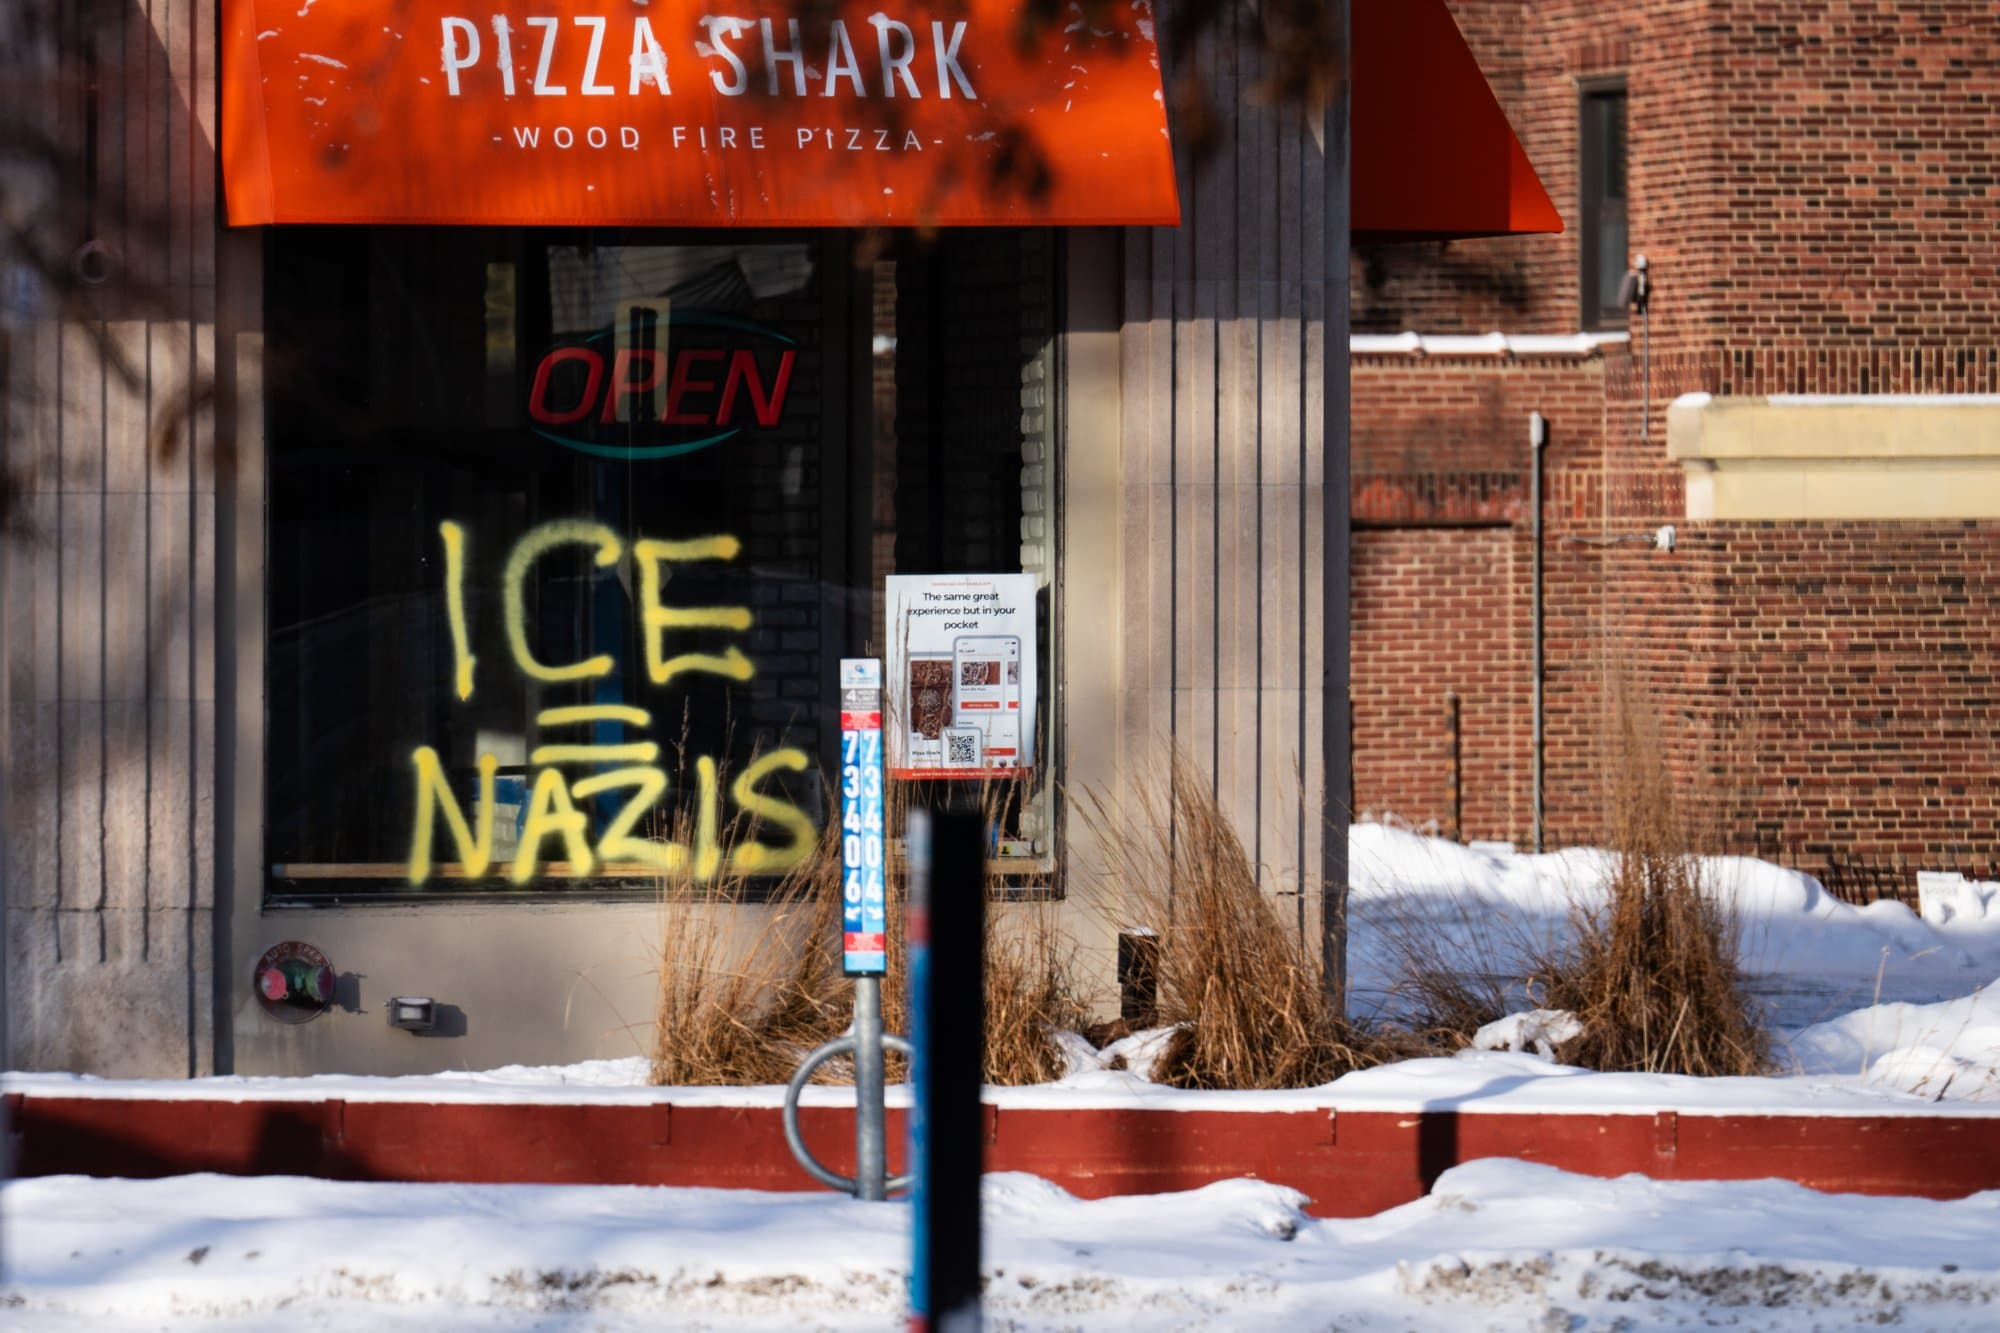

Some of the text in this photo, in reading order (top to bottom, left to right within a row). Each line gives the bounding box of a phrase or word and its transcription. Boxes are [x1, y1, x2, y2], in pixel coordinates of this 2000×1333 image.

[440, 14, 978, 99] PIZZA SHARK
[673, 126, 765, 149] FIRE
[528, 347, 797, 426] OPEN
[440, 519, 755, 700] ICE
[923, 592, 941, 600] The
[973, 592, 999, 603] great
[963, 606, 980, 614] but
[983, 605, 991, 614] in
[994, 607, 1016, 616] your
[944, 620, 978, 631] pocket
[409, 748, 819, 886] NAZIS
